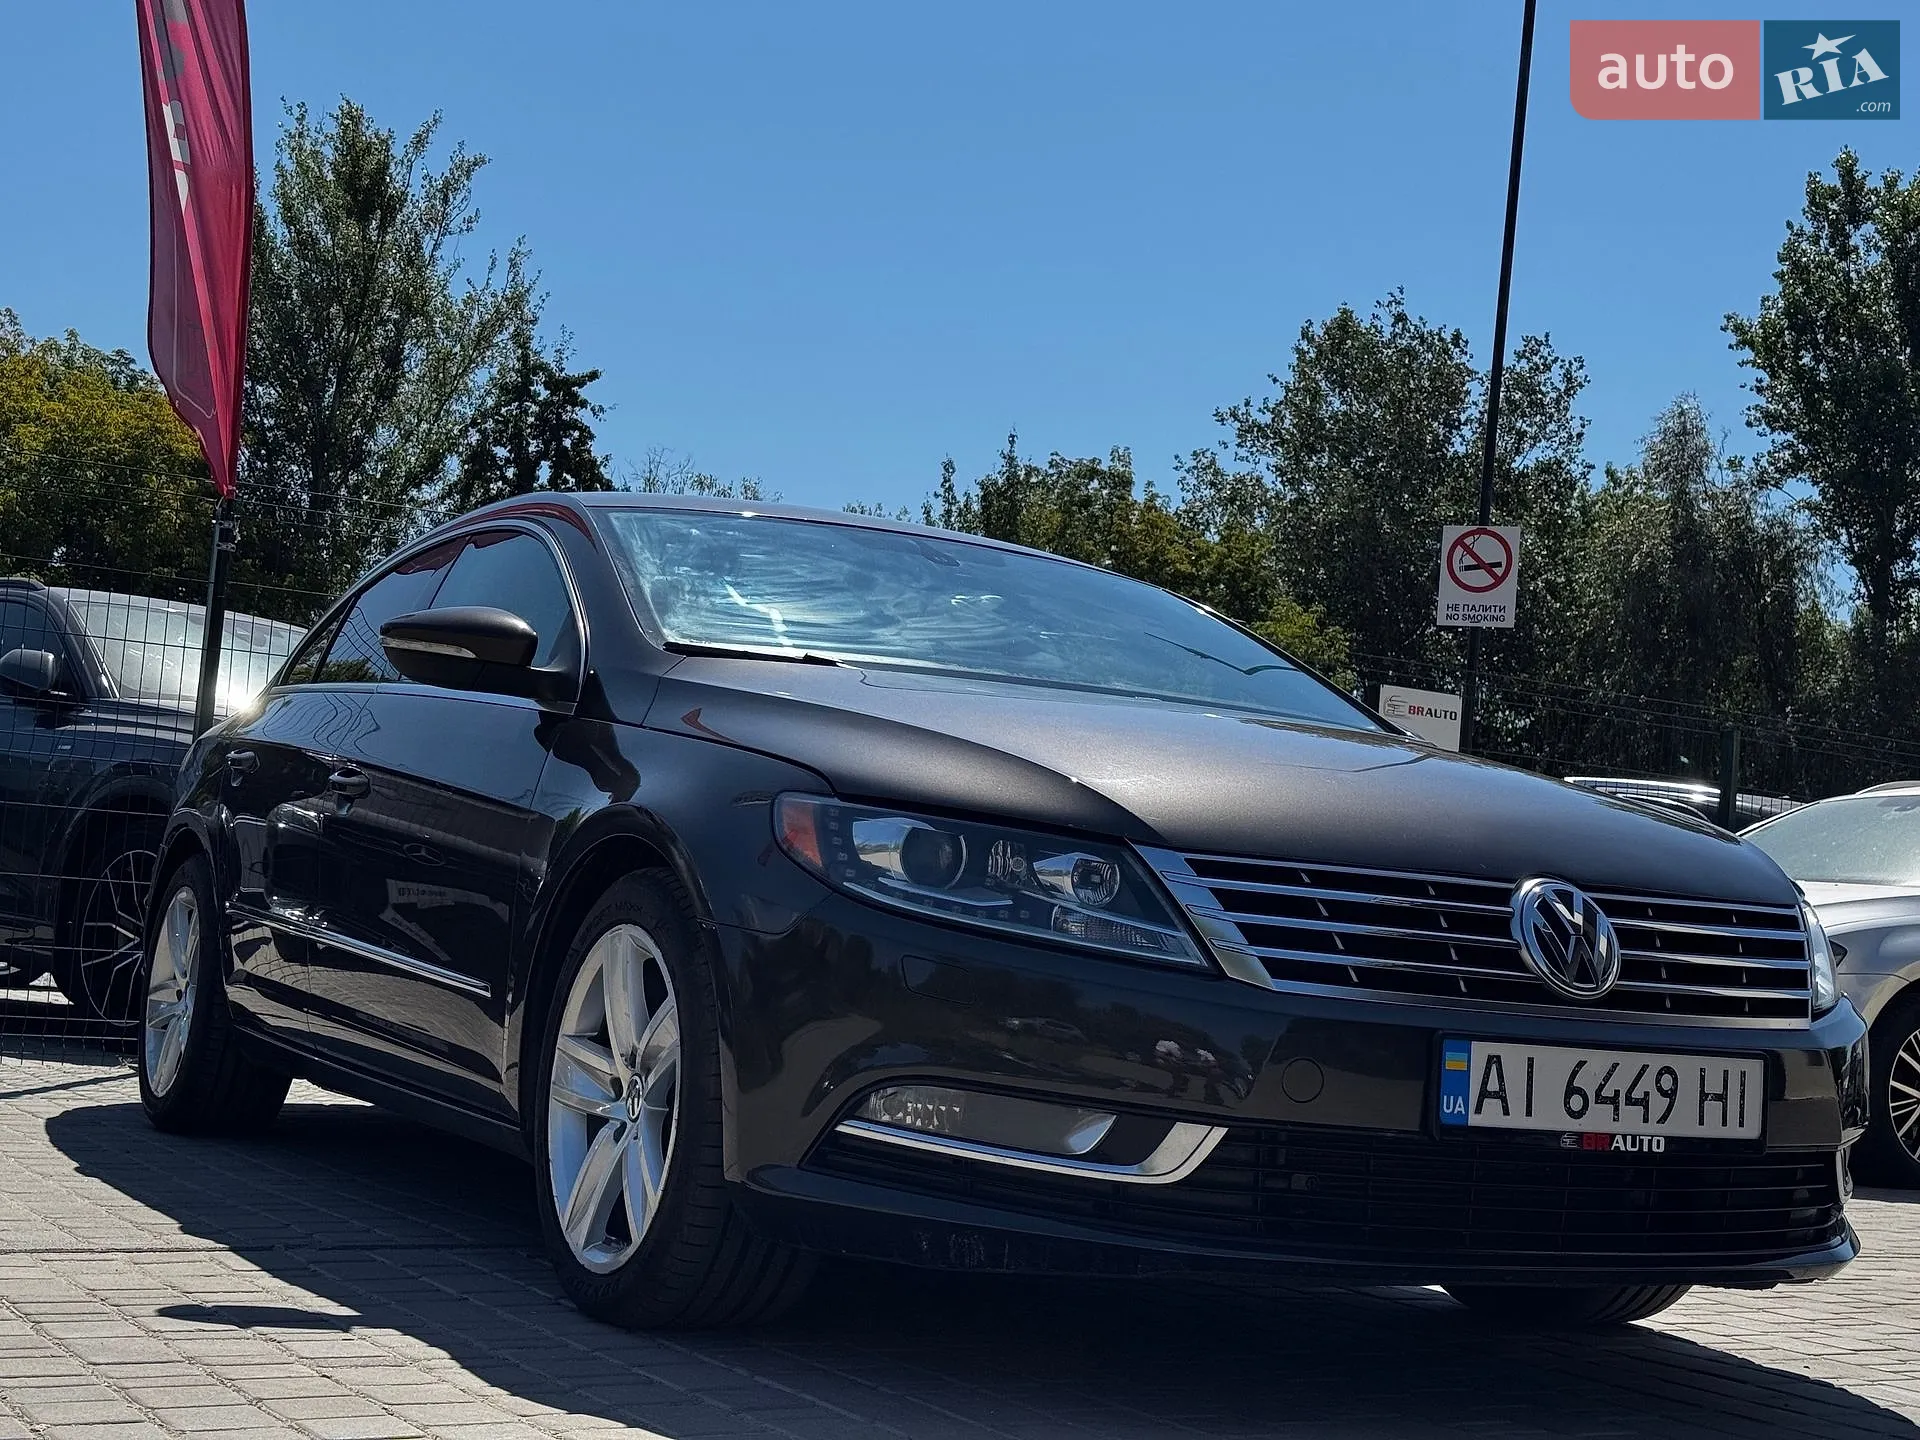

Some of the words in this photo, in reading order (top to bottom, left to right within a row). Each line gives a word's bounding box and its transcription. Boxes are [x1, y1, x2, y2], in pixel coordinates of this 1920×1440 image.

[1446, 603, 1460, 612] НЕ
[1462, 604, 1506, 614] ПАЛИТИ
[1445, 613, 1460, 621] NO
[1461, 614, 1506, 623] SMOKING
[1408, 705, 1458, 721] BRAUTO
[1474, 1054, 1535, 1117] AI
[1563, 1059, 1679, 1125] 6449
[1698, 1067, 1747, 1128] HI
[1442, 1095, 1466, 1115] UA
